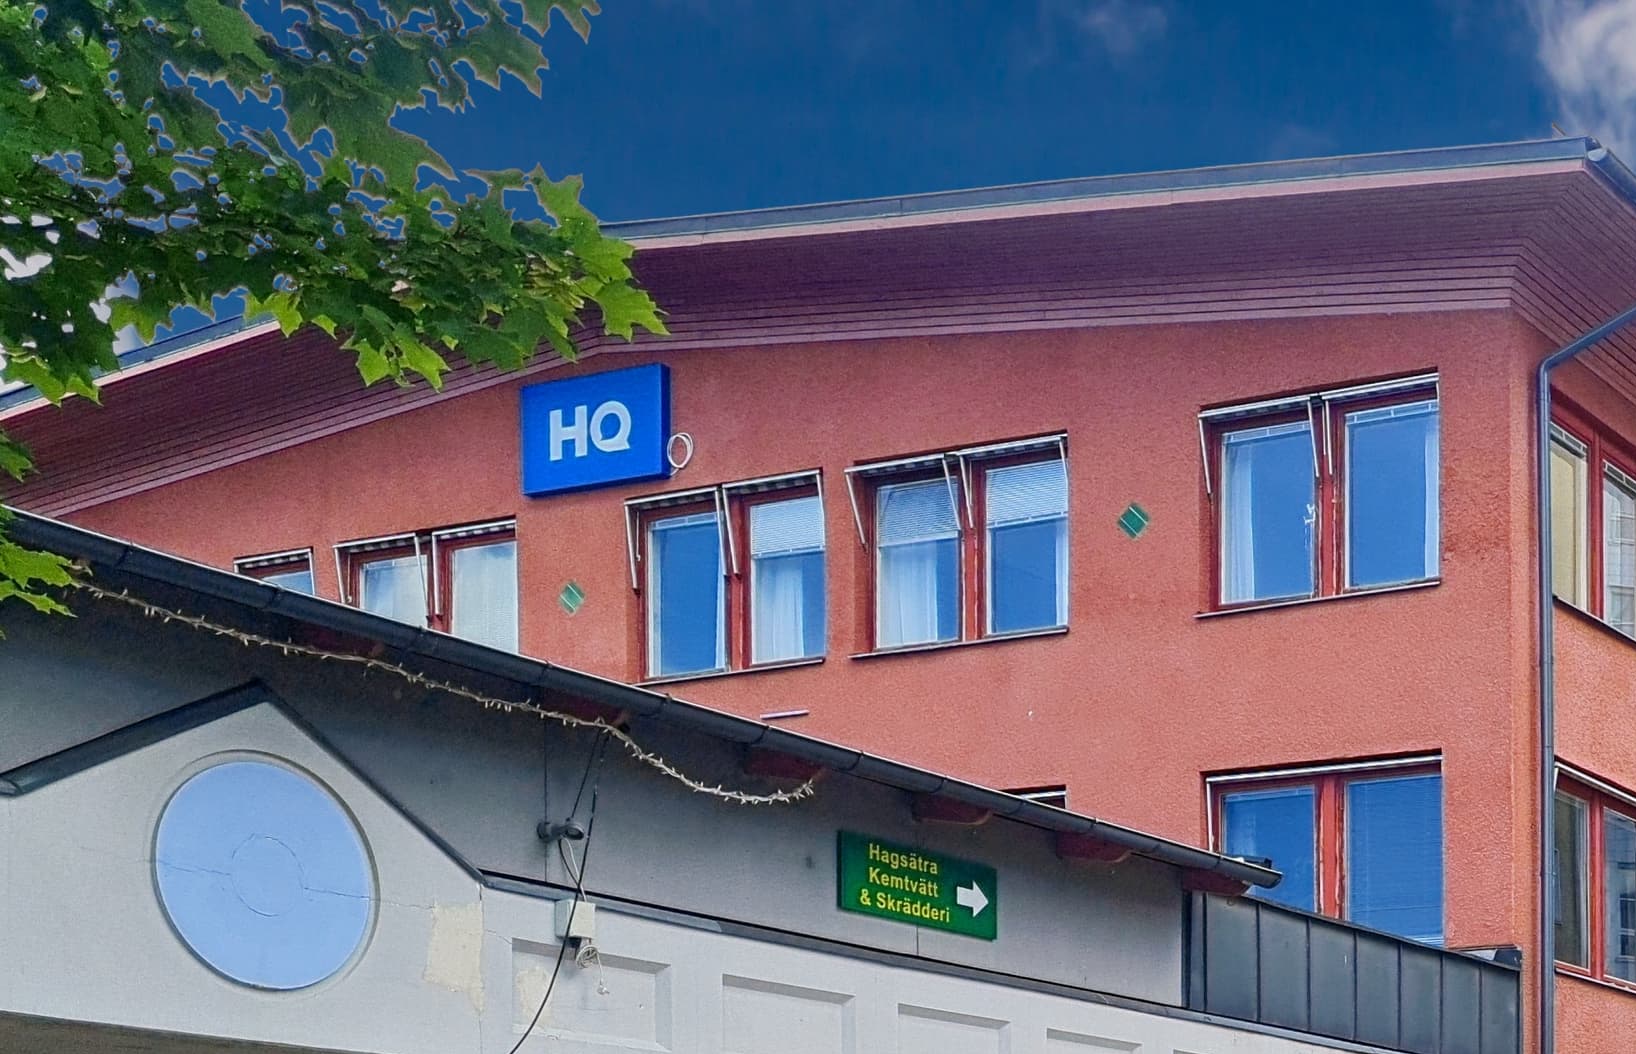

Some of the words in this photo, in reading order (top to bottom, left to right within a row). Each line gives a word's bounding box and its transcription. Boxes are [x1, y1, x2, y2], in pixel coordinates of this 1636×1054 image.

[549, 400, 632, 462] HQ
[868, 843, 938, 875] Hagsätra
[868, 866, 938, 898] Kemtvätt
[859, 888, 872, 906] &
[876, 892, 950, 923] Skrädderi
